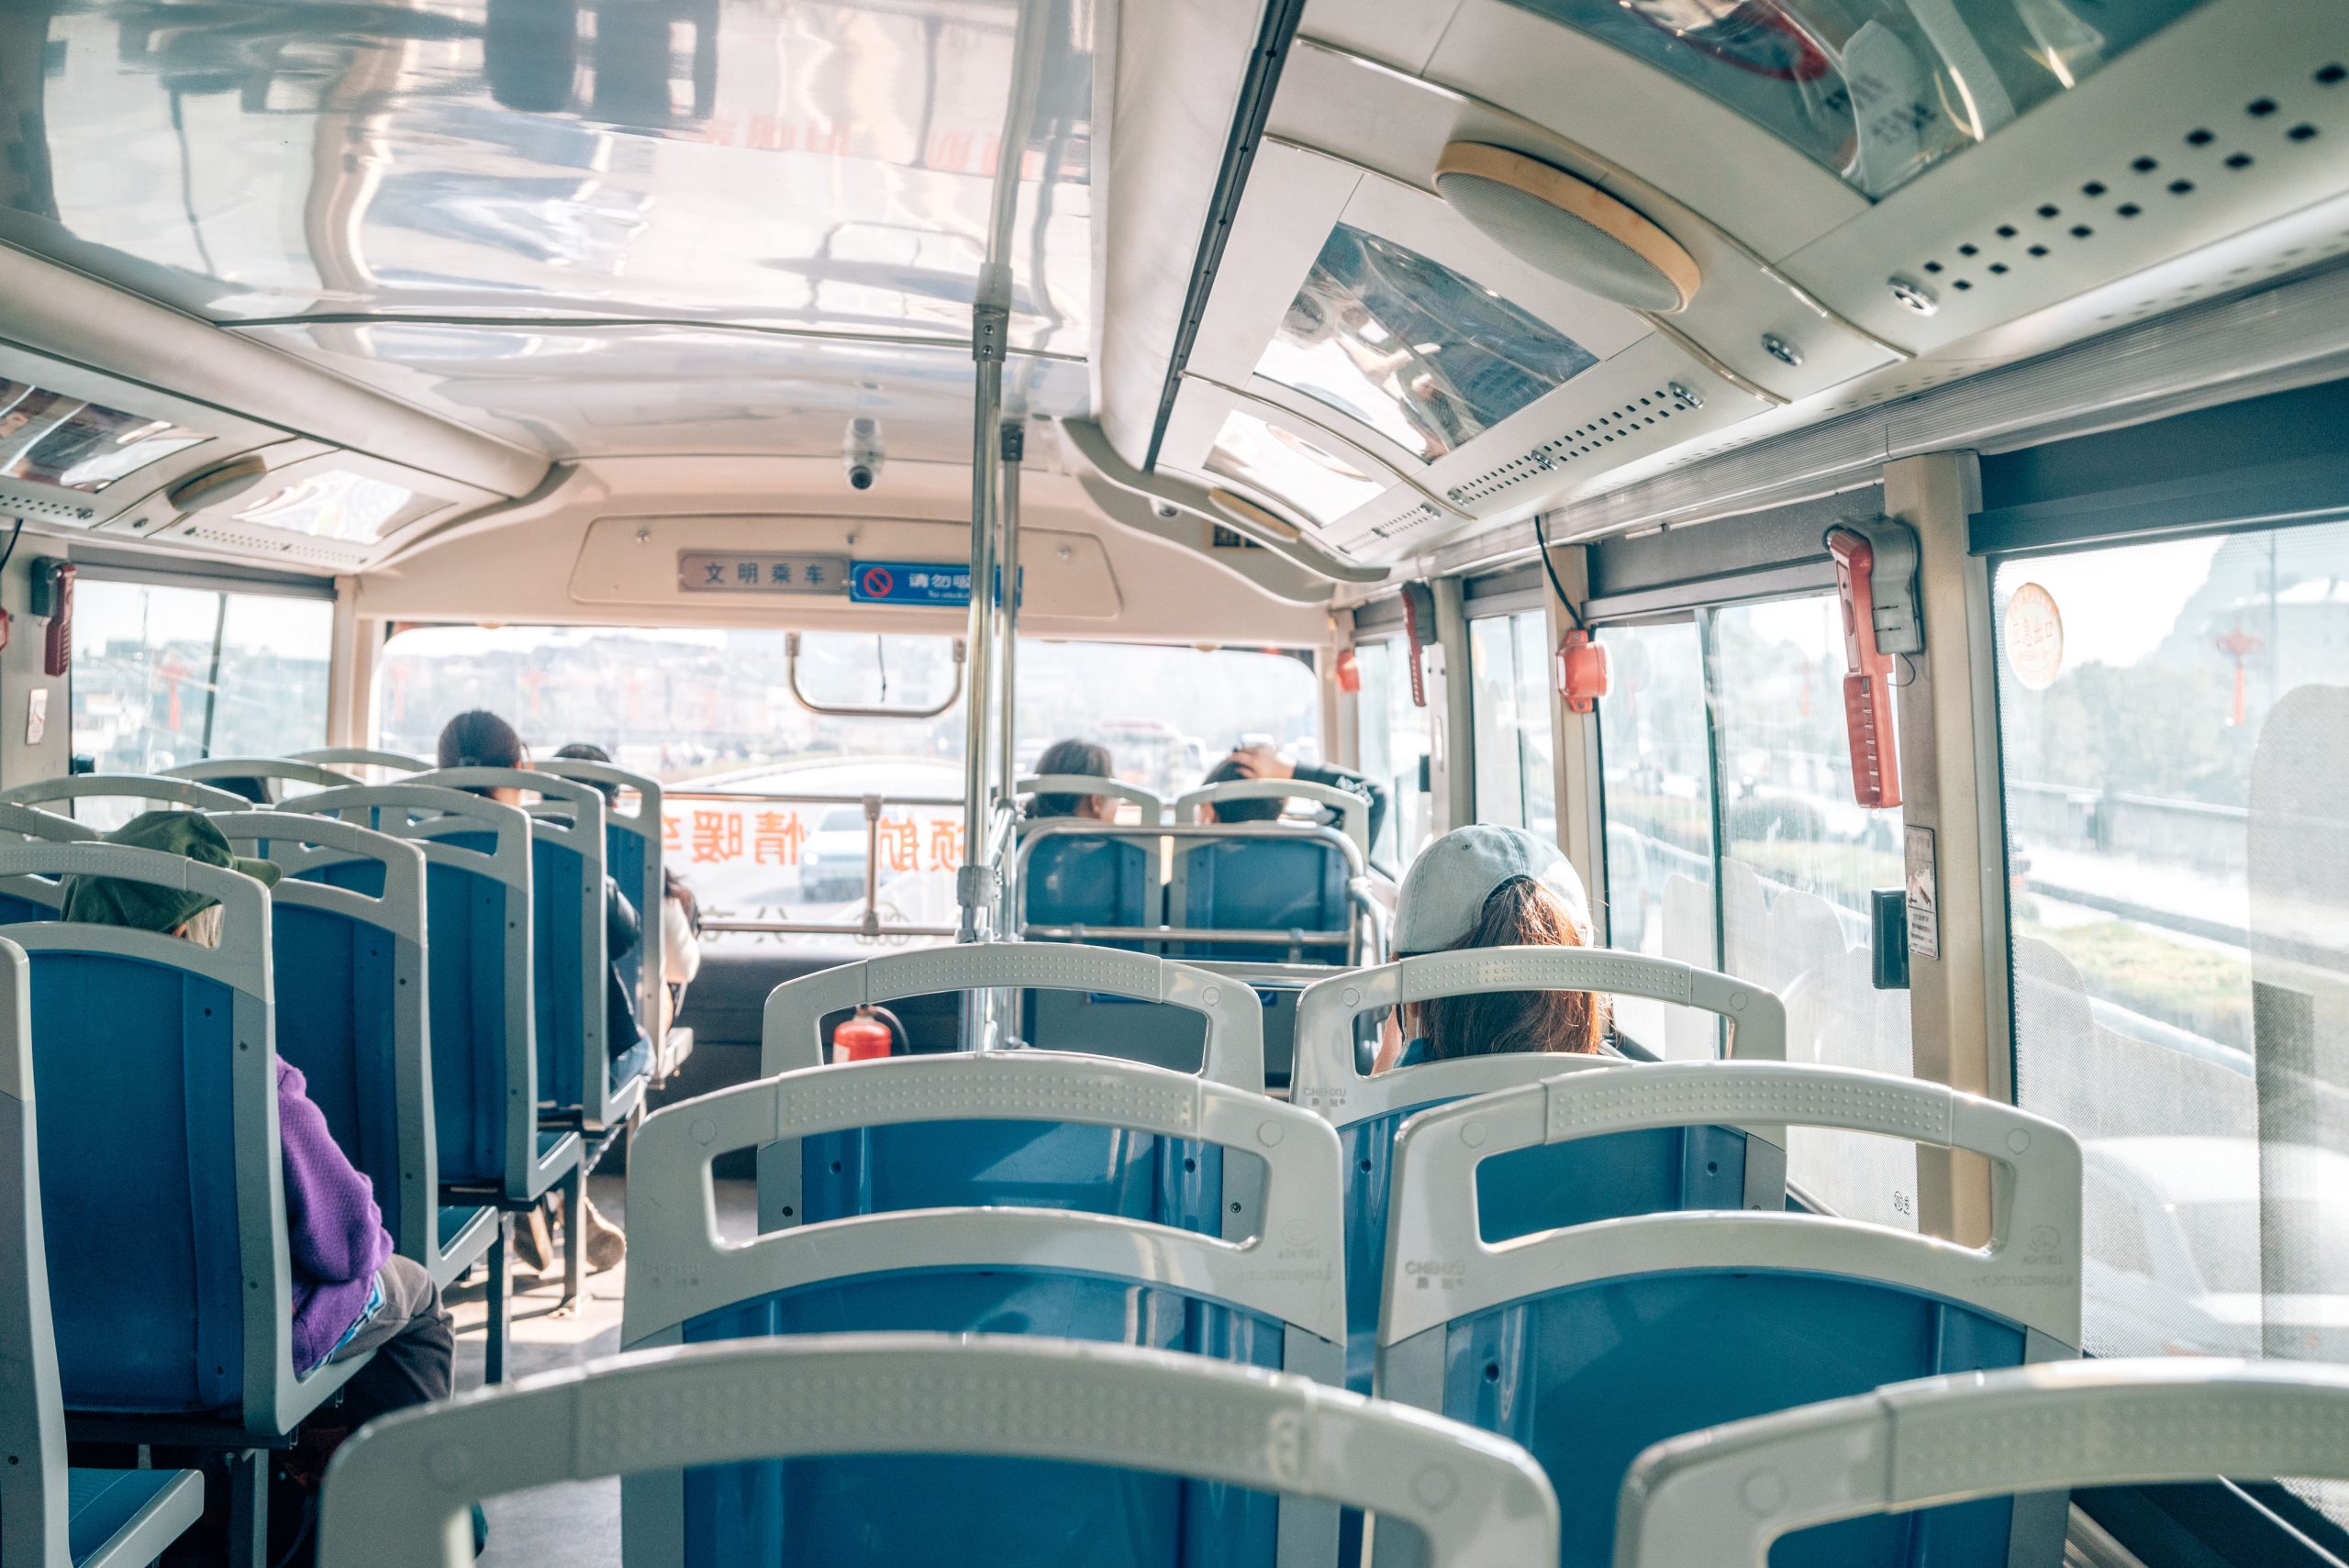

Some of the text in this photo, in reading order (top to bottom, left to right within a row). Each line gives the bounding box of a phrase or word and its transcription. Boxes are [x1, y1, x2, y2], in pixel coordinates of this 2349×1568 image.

[704, 562, 825, 584] 文明乘车
[909, 573, 971, 588] 请勿吸
